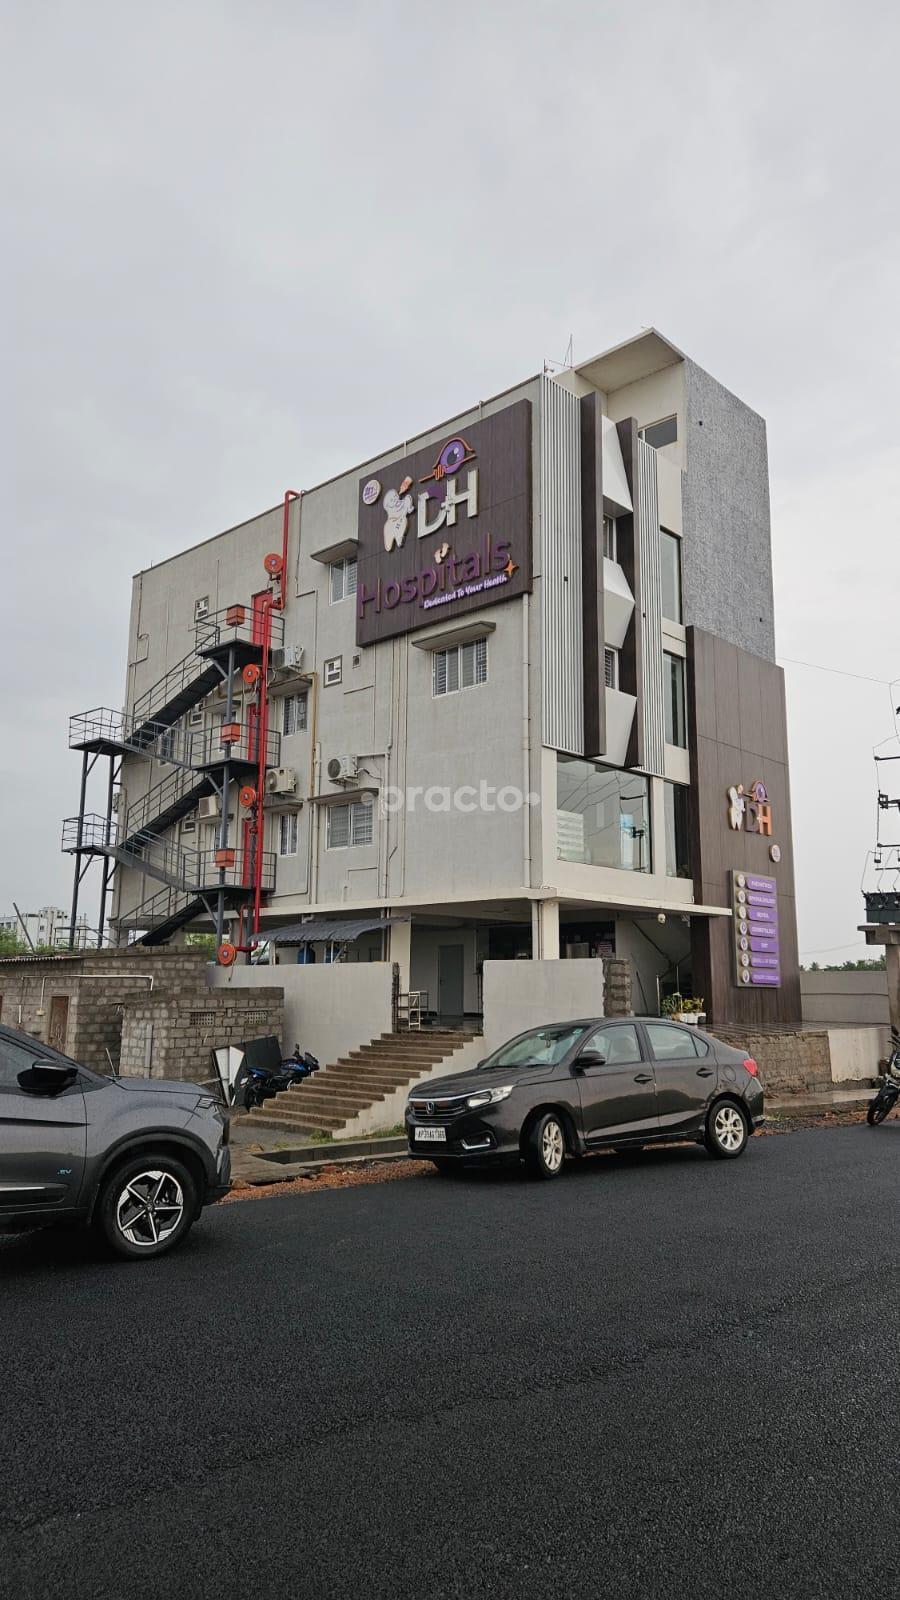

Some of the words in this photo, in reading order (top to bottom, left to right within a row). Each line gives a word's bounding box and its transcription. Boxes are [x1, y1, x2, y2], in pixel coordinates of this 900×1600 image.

[356, 532, 511, 619] Hospitals
[457, 588, 465, 598] To
[465, 582, 483, 594] Your
